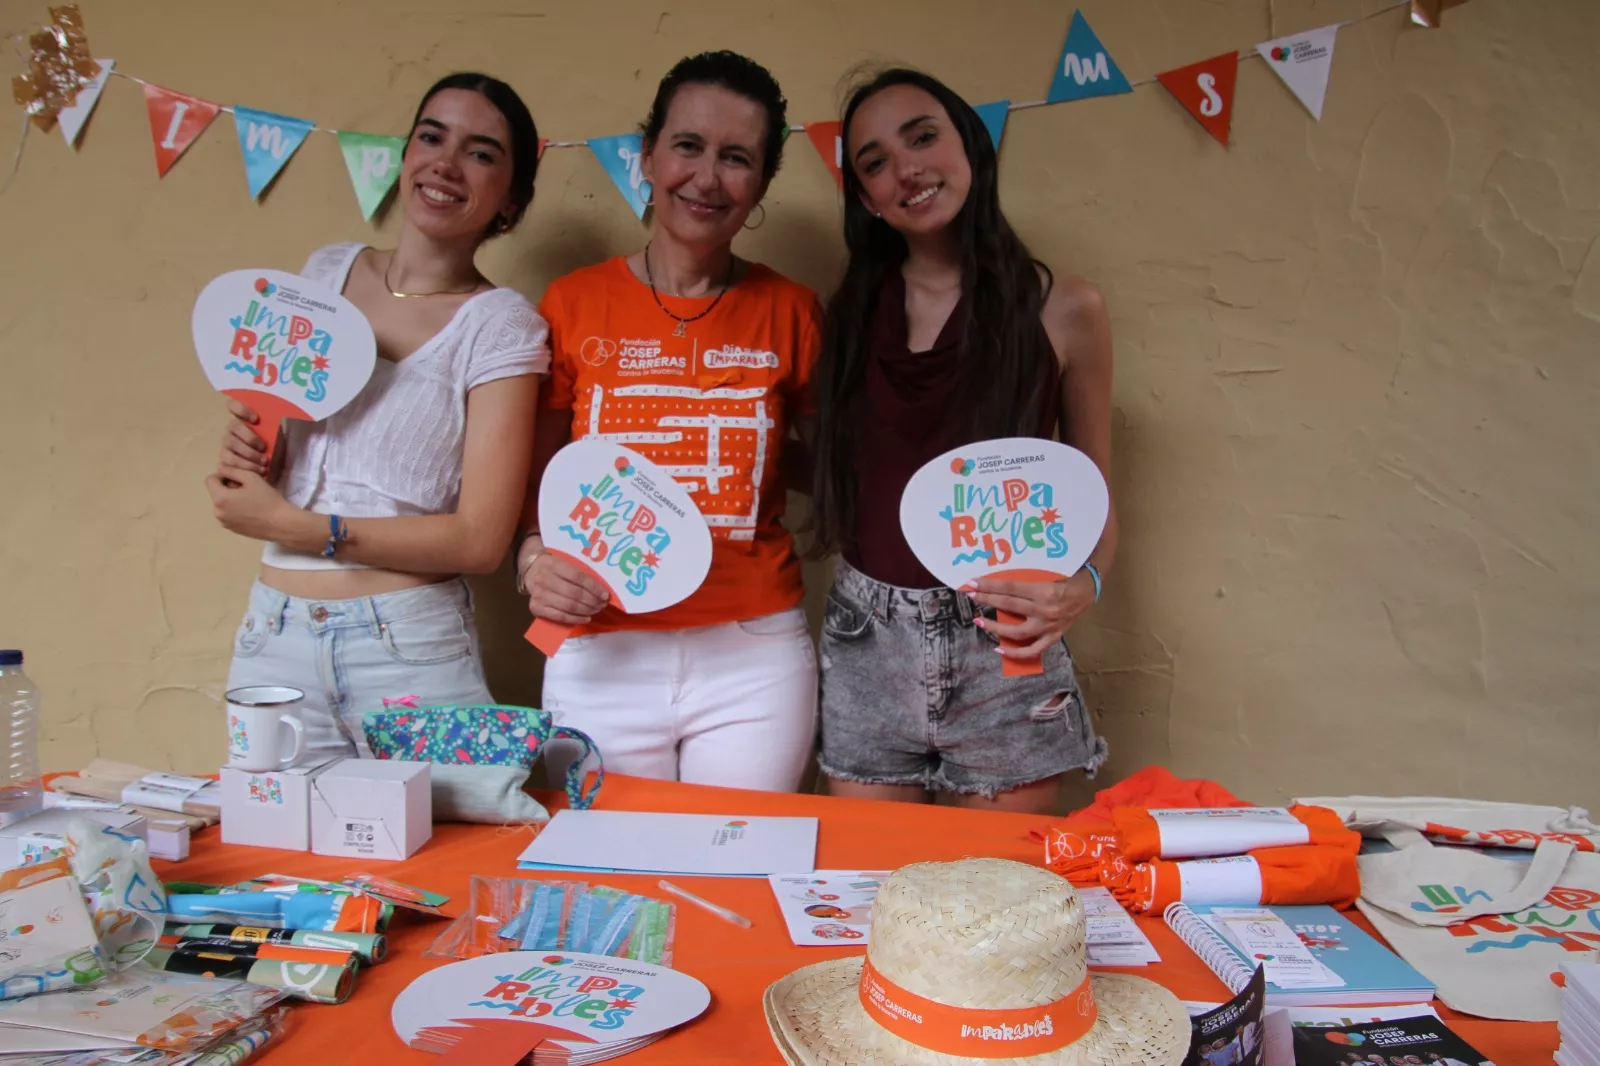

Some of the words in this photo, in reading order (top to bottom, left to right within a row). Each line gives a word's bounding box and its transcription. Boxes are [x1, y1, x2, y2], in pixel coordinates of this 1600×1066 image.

[619, 346, 661, 358] JOSEP
[619, 356, 687, 369] CARRERAS
[978, 460, 1003, 469] JOSEP
[1004, 454, 1046, 466] CARRERAS
[633, 475, 656, 493] JOSEP
[653, 489, 686, 519] CARRERAS
[1295, 924, 1342, 933] STOP
[606, 966, 658, 977] CARRERAS
[869, 986, 885, 1002] JOSEP
[885, 998, 923, 1024] CARRERAS
[1201, 1006, 1237, 1029] JOSEP
[1362, 1026, 1399, 1035] Fundación
[1368, 1030, 1406, 1040] JOSEP
[1374, 1032, 1439, 1045] CARRERAS
